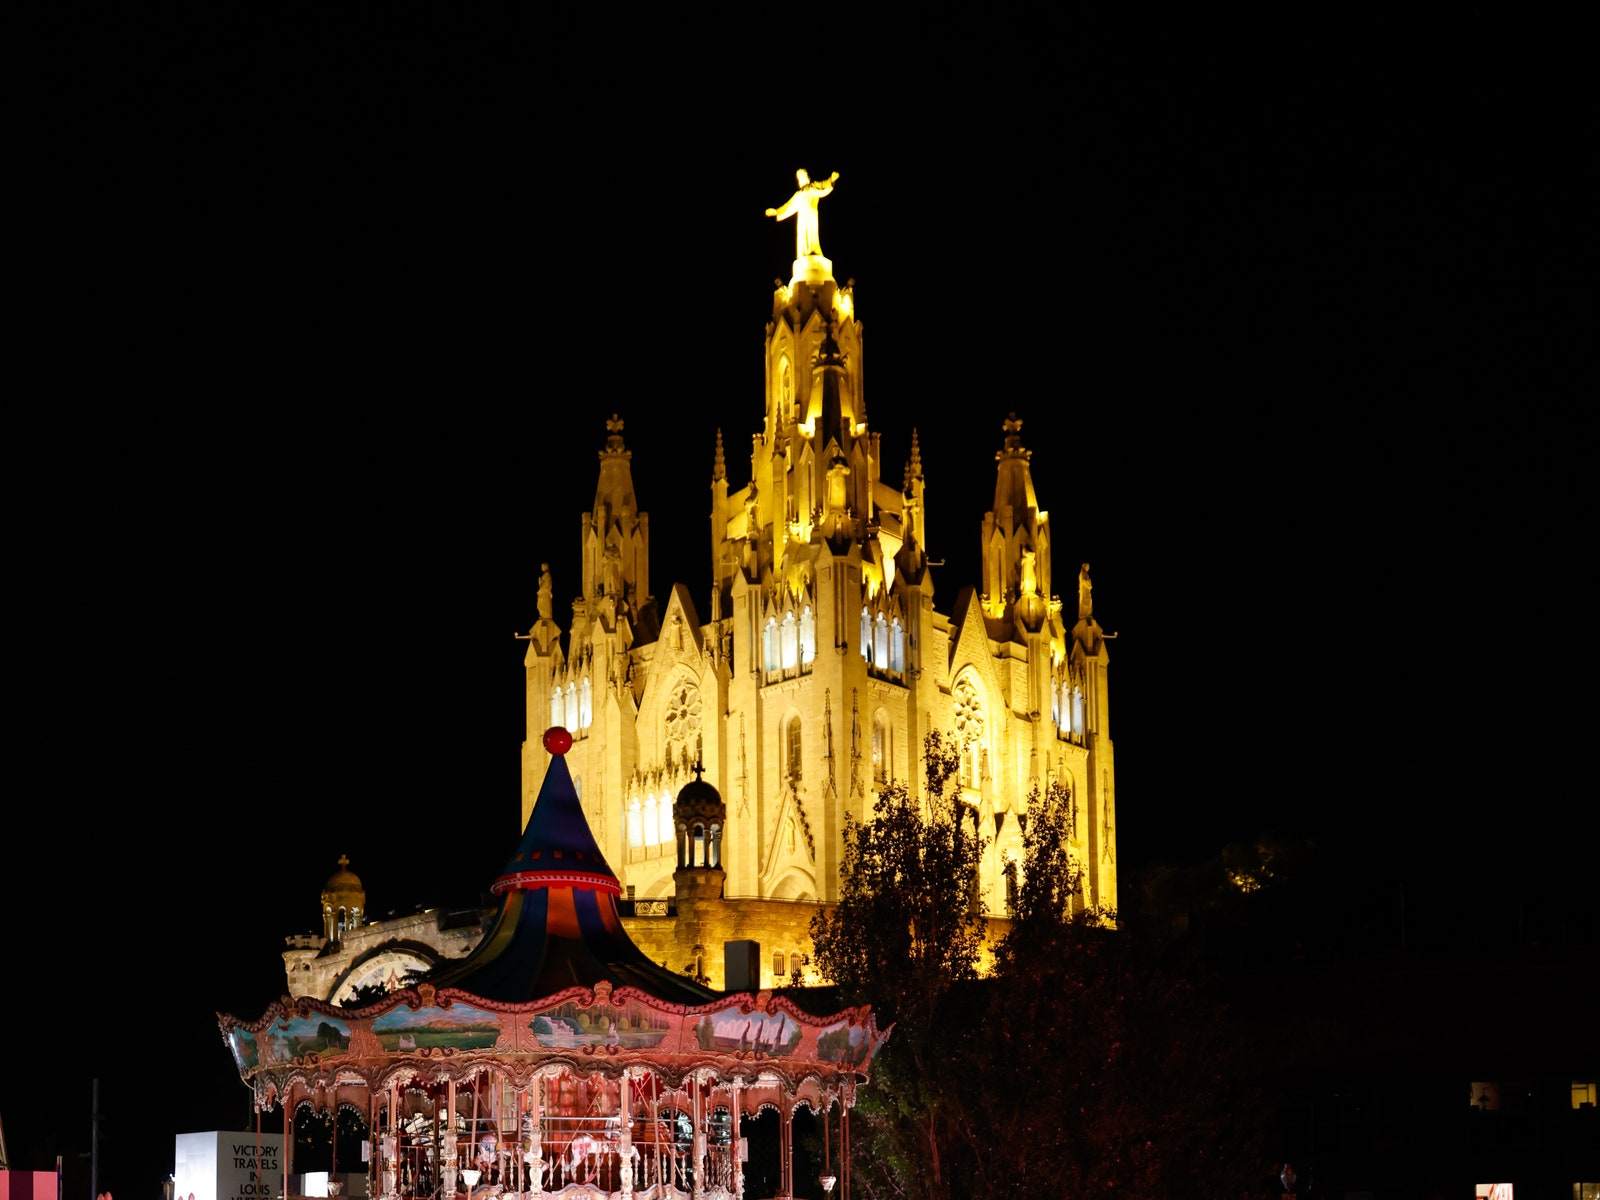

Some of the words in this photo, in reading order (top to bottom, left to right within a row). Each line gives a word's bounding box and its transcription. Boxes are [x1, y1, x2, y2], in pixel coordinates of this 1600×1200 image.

[233, 1145, 278, 1157] VICTORY
[233, 1157, 278, 1170] TRAVELS
[240, 1184, 270, 1195] LOUIS
